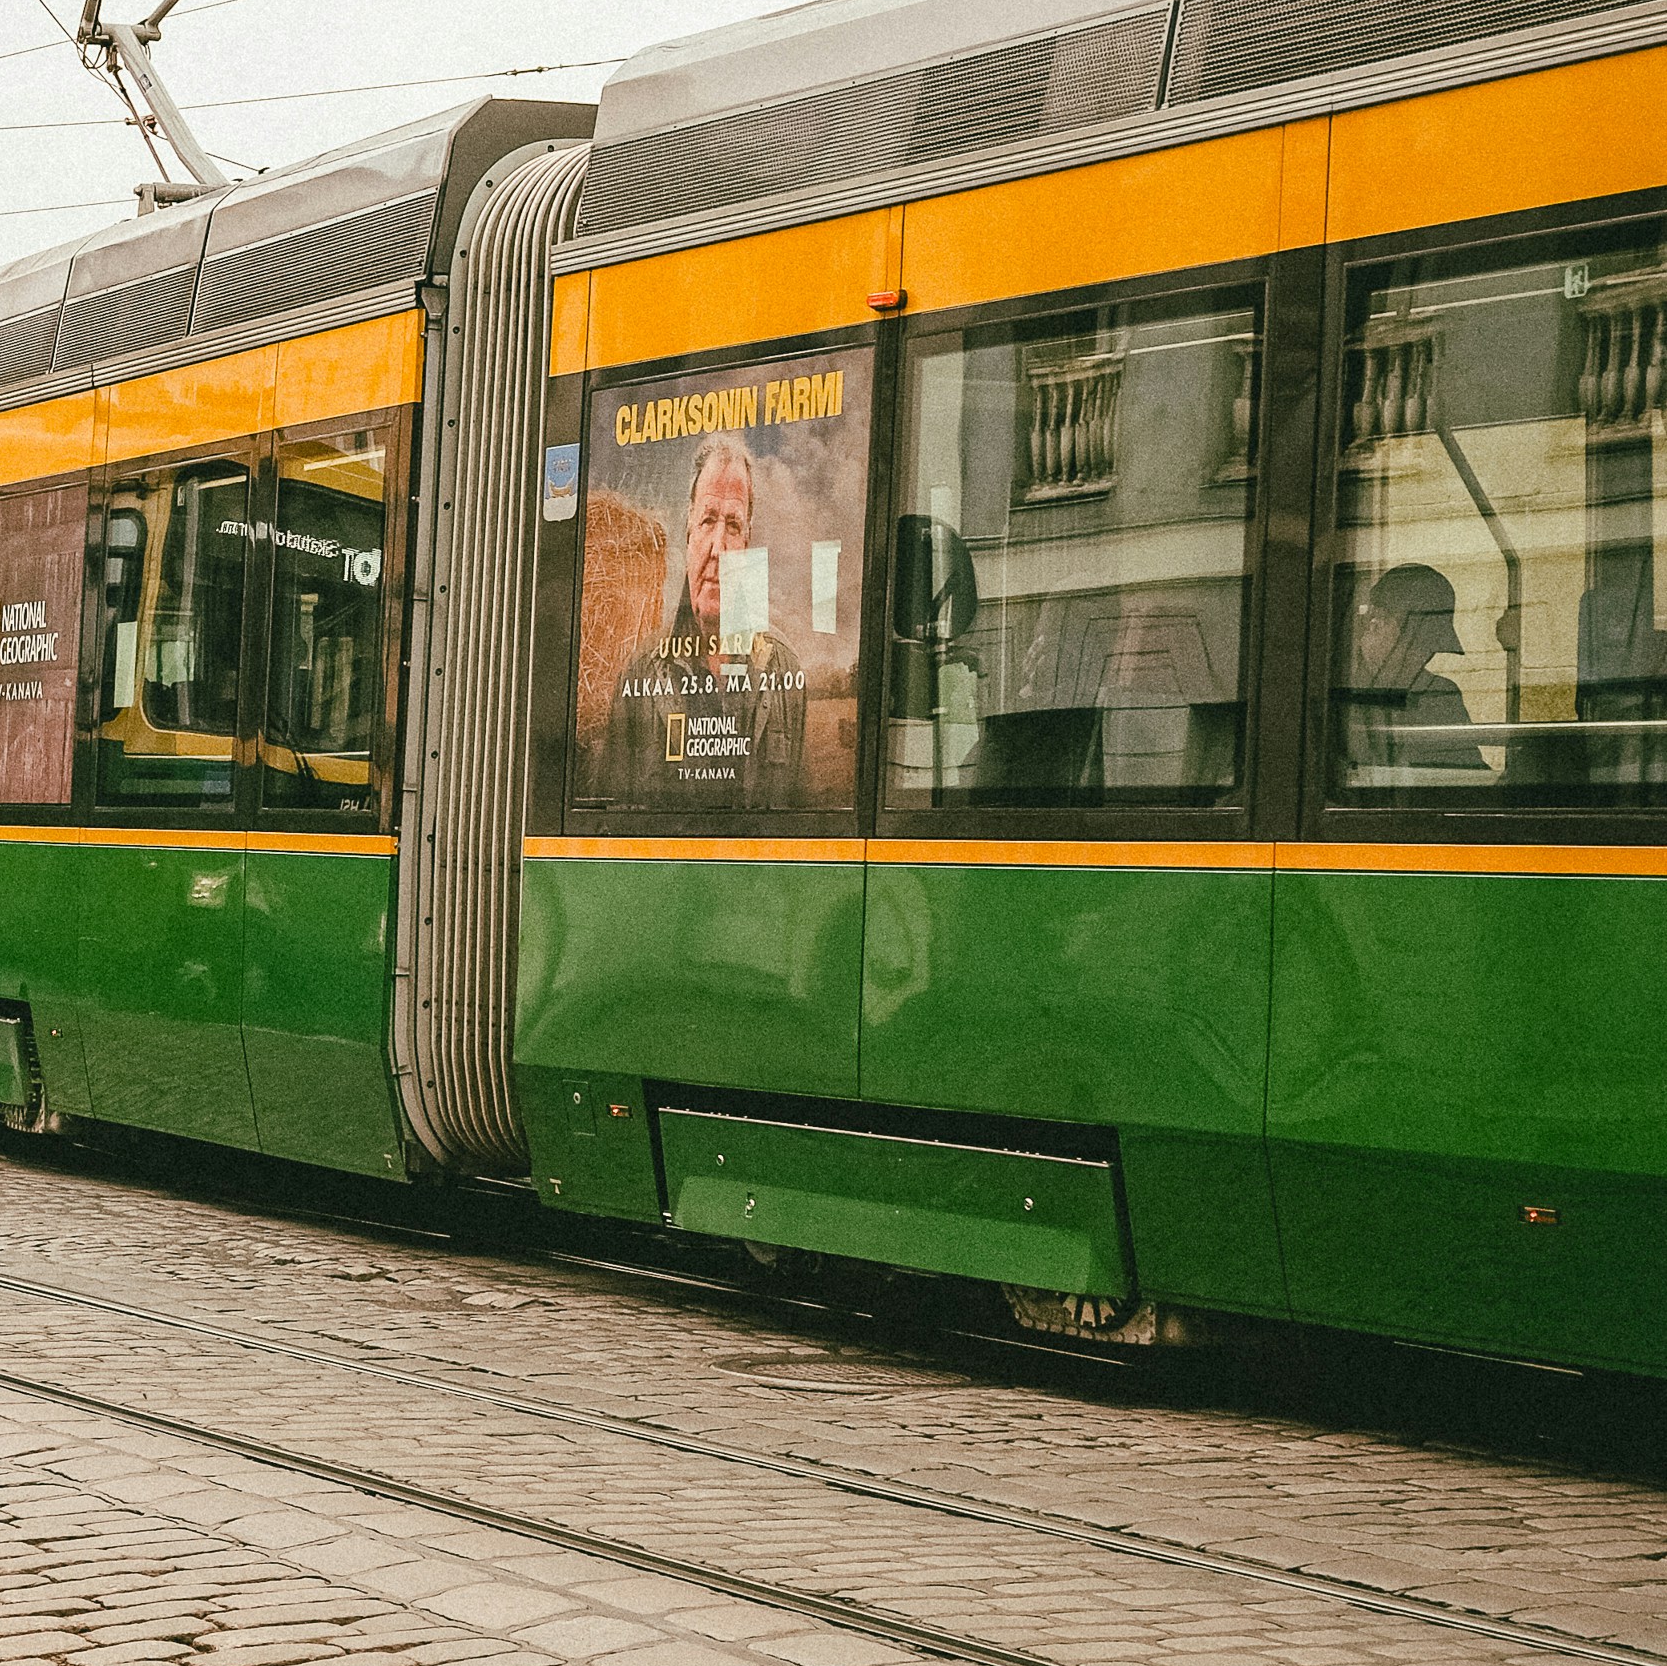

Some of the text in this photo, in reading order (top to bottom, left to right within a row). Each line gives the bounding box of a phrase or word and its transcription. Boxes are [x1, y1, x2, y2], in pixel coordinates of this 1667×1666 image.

[615, 370, 844, 447] CLARKSONIN FARMI
[1, 600, 47, 633] NATIONAL
[0, 632, 59, 666] GEOGRAPHIC
[659, 632, 767, 659] UUSI SARJ
[621, 670, 806, 698] ALKAA 25.8. MA 21.00
[687, 716, 738, 736] NATIONAL
[686, 737, 752, 757] GEOGRAPHIC
[677, 767, 736, 780] TV-KANAVA
